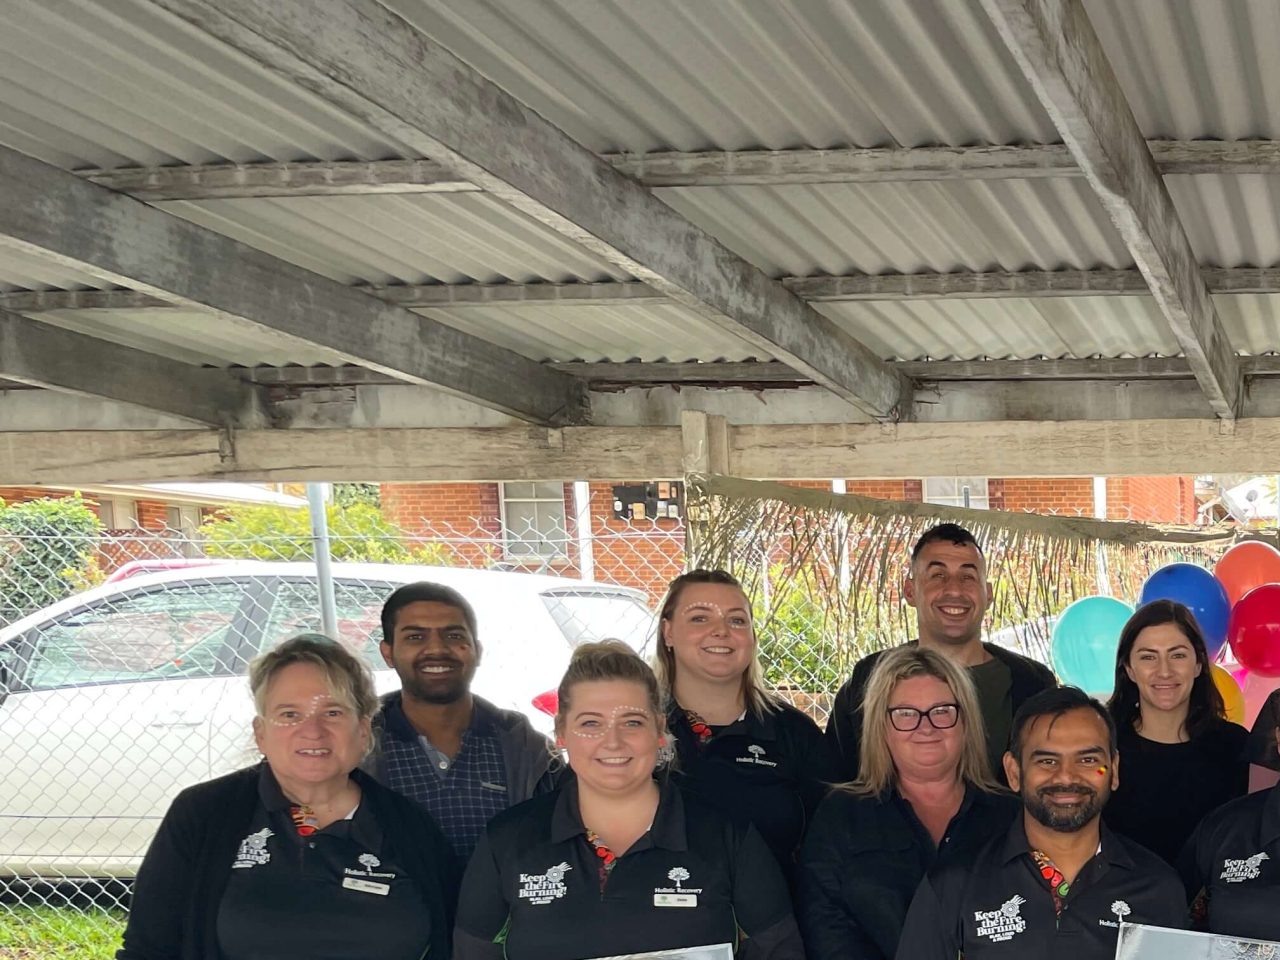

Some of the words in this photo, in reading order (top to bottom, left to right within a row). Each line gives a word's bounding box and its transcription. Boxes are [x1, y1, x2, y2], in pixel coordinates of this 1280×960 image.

[519, 873, 546, 884] Keep
[525, 881, 541, 890] the
[542, 880, 565, 890] Fire
[518, 886, 568, 899] Burning!
[974, 910, 1002, 922] Keep
[981, 918, 999, 928] the
[999, 916, 1023, 926] Fire
[976, 920, 1026, 937] Burning!
